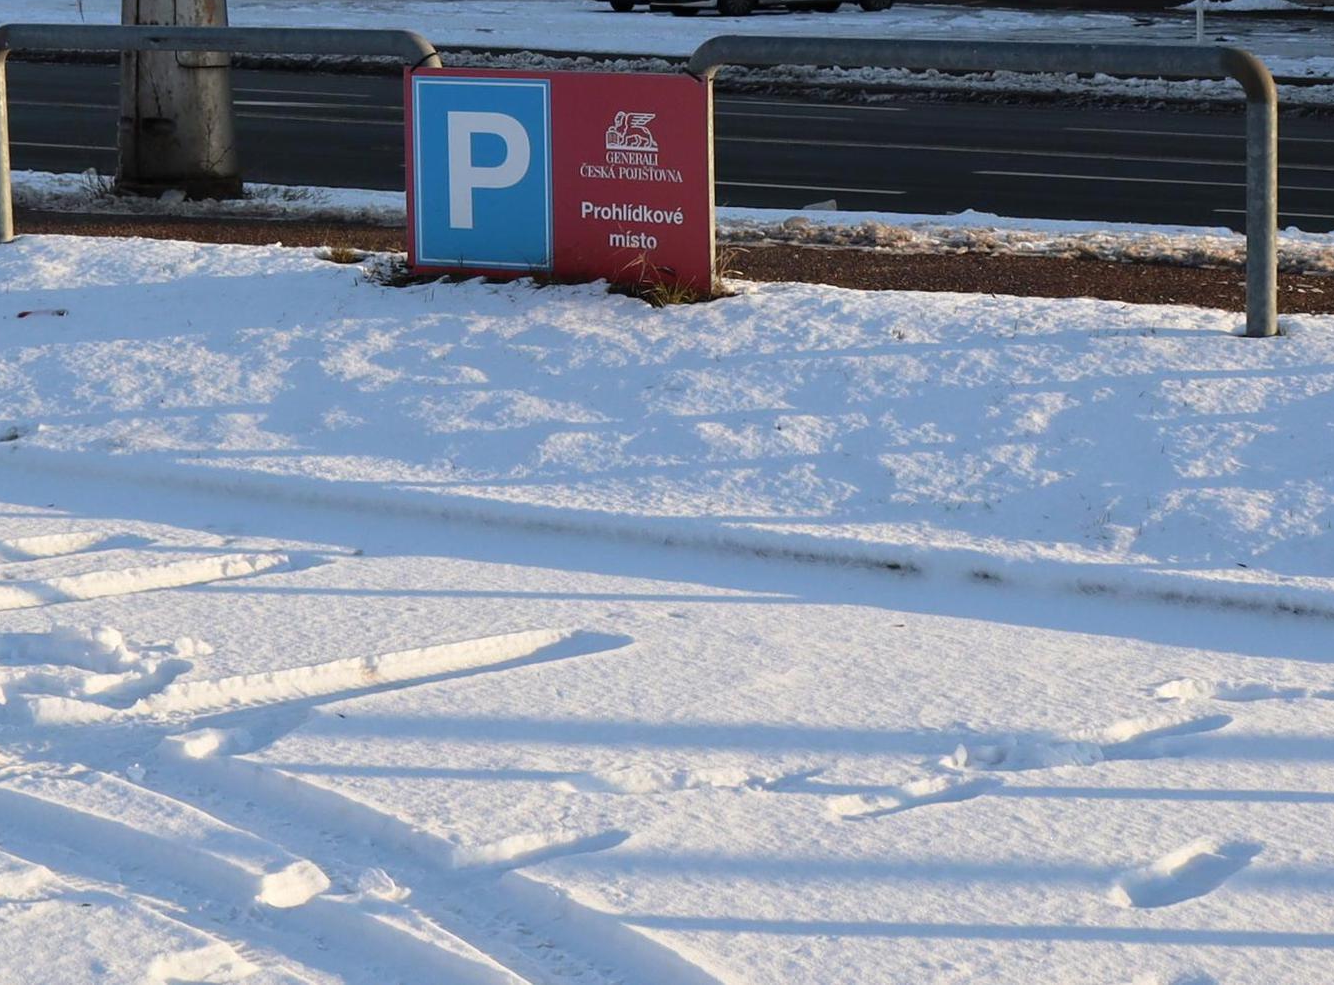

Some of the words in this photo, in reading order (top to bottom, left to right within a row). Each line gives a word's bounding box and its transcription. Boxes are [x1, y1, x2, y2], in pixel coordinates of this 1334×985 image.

[605, 150, 659, 166] GENERALI
[447, 110, 532, 229] P
[579, 163, 616, 180] ČESKÁ
[619, 164, 684, 184] POJIŠŤOVNA
[581, 200, 684, 225] Prohlídkové
[609, 230, 658, 250] místo
